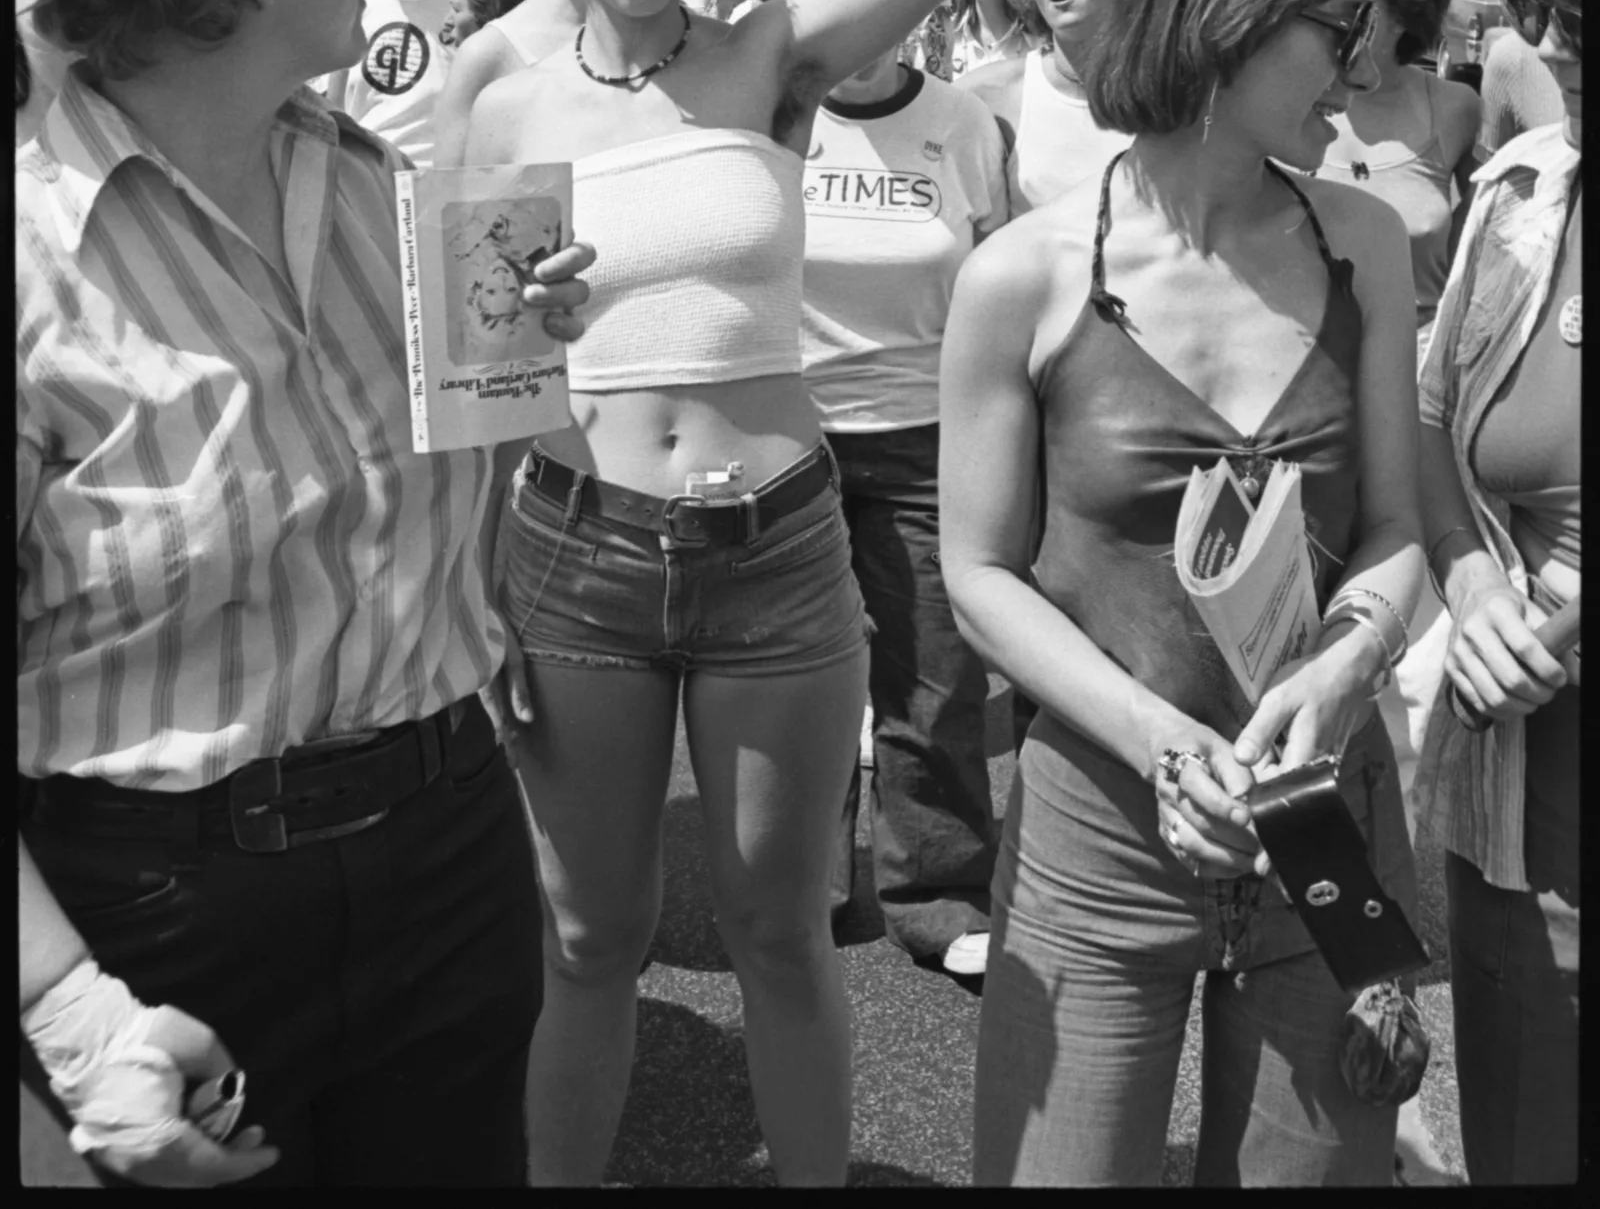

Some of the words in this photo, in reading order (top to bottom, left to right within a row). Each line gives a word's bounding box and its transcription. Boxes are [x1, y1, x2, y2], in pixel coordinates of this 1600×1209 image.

[924, 140, 944, 155] DYKE
[438, 378, 486, 391] Library
[486, 373, 531, 389] Cartland
[478, 385, 523, 400] Bantam
[523, 382, 542, 399] The
